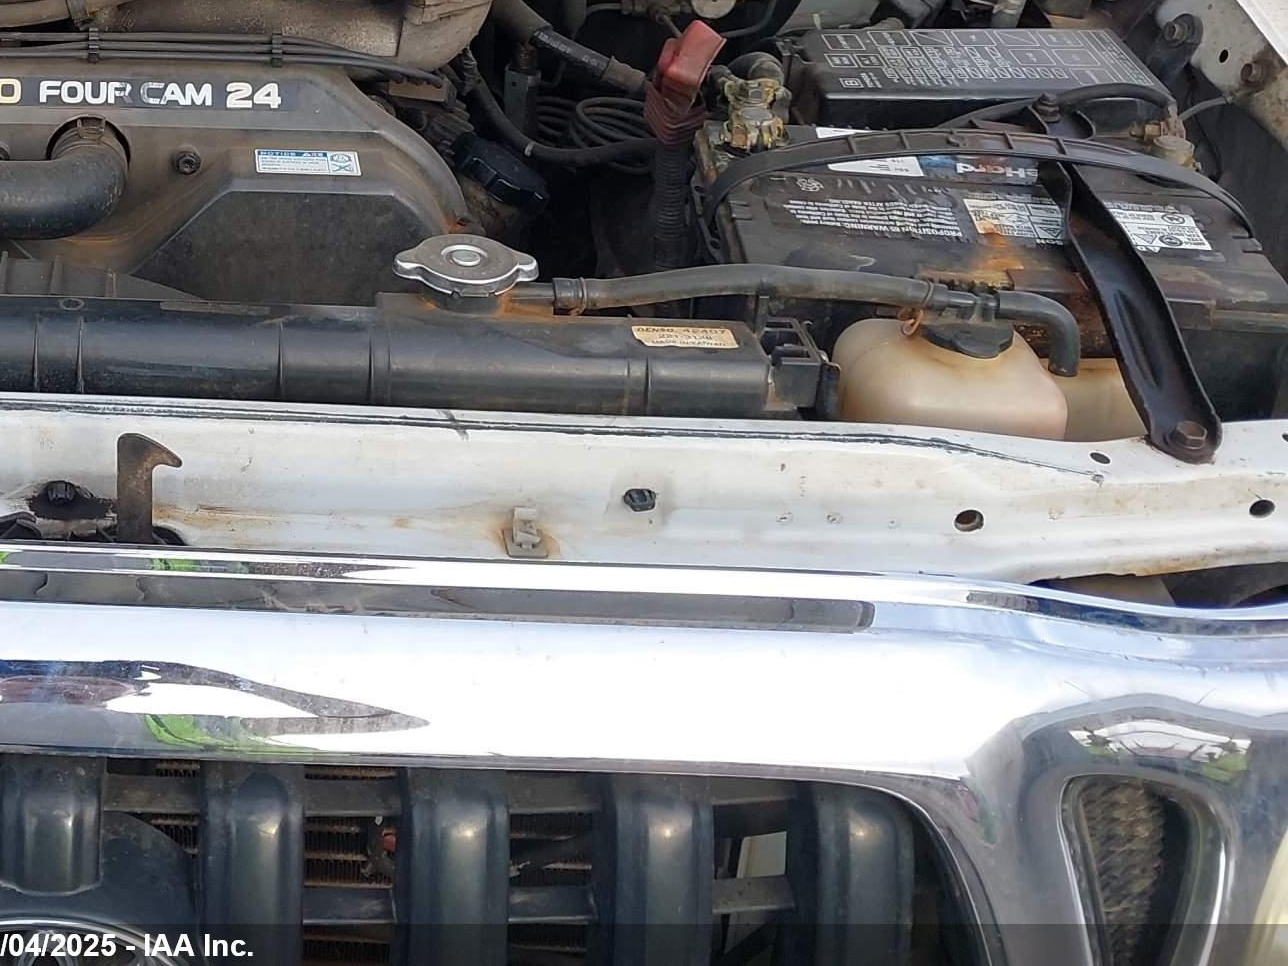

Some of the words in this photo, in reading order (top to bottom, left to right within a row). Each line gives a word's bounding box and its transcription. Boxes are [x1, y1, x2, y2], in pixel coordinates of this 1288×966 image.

[39, 80, 133, 105] FOUR
[140, 82, 212, 106] CAM
[225, 82, 281, 109] 24
